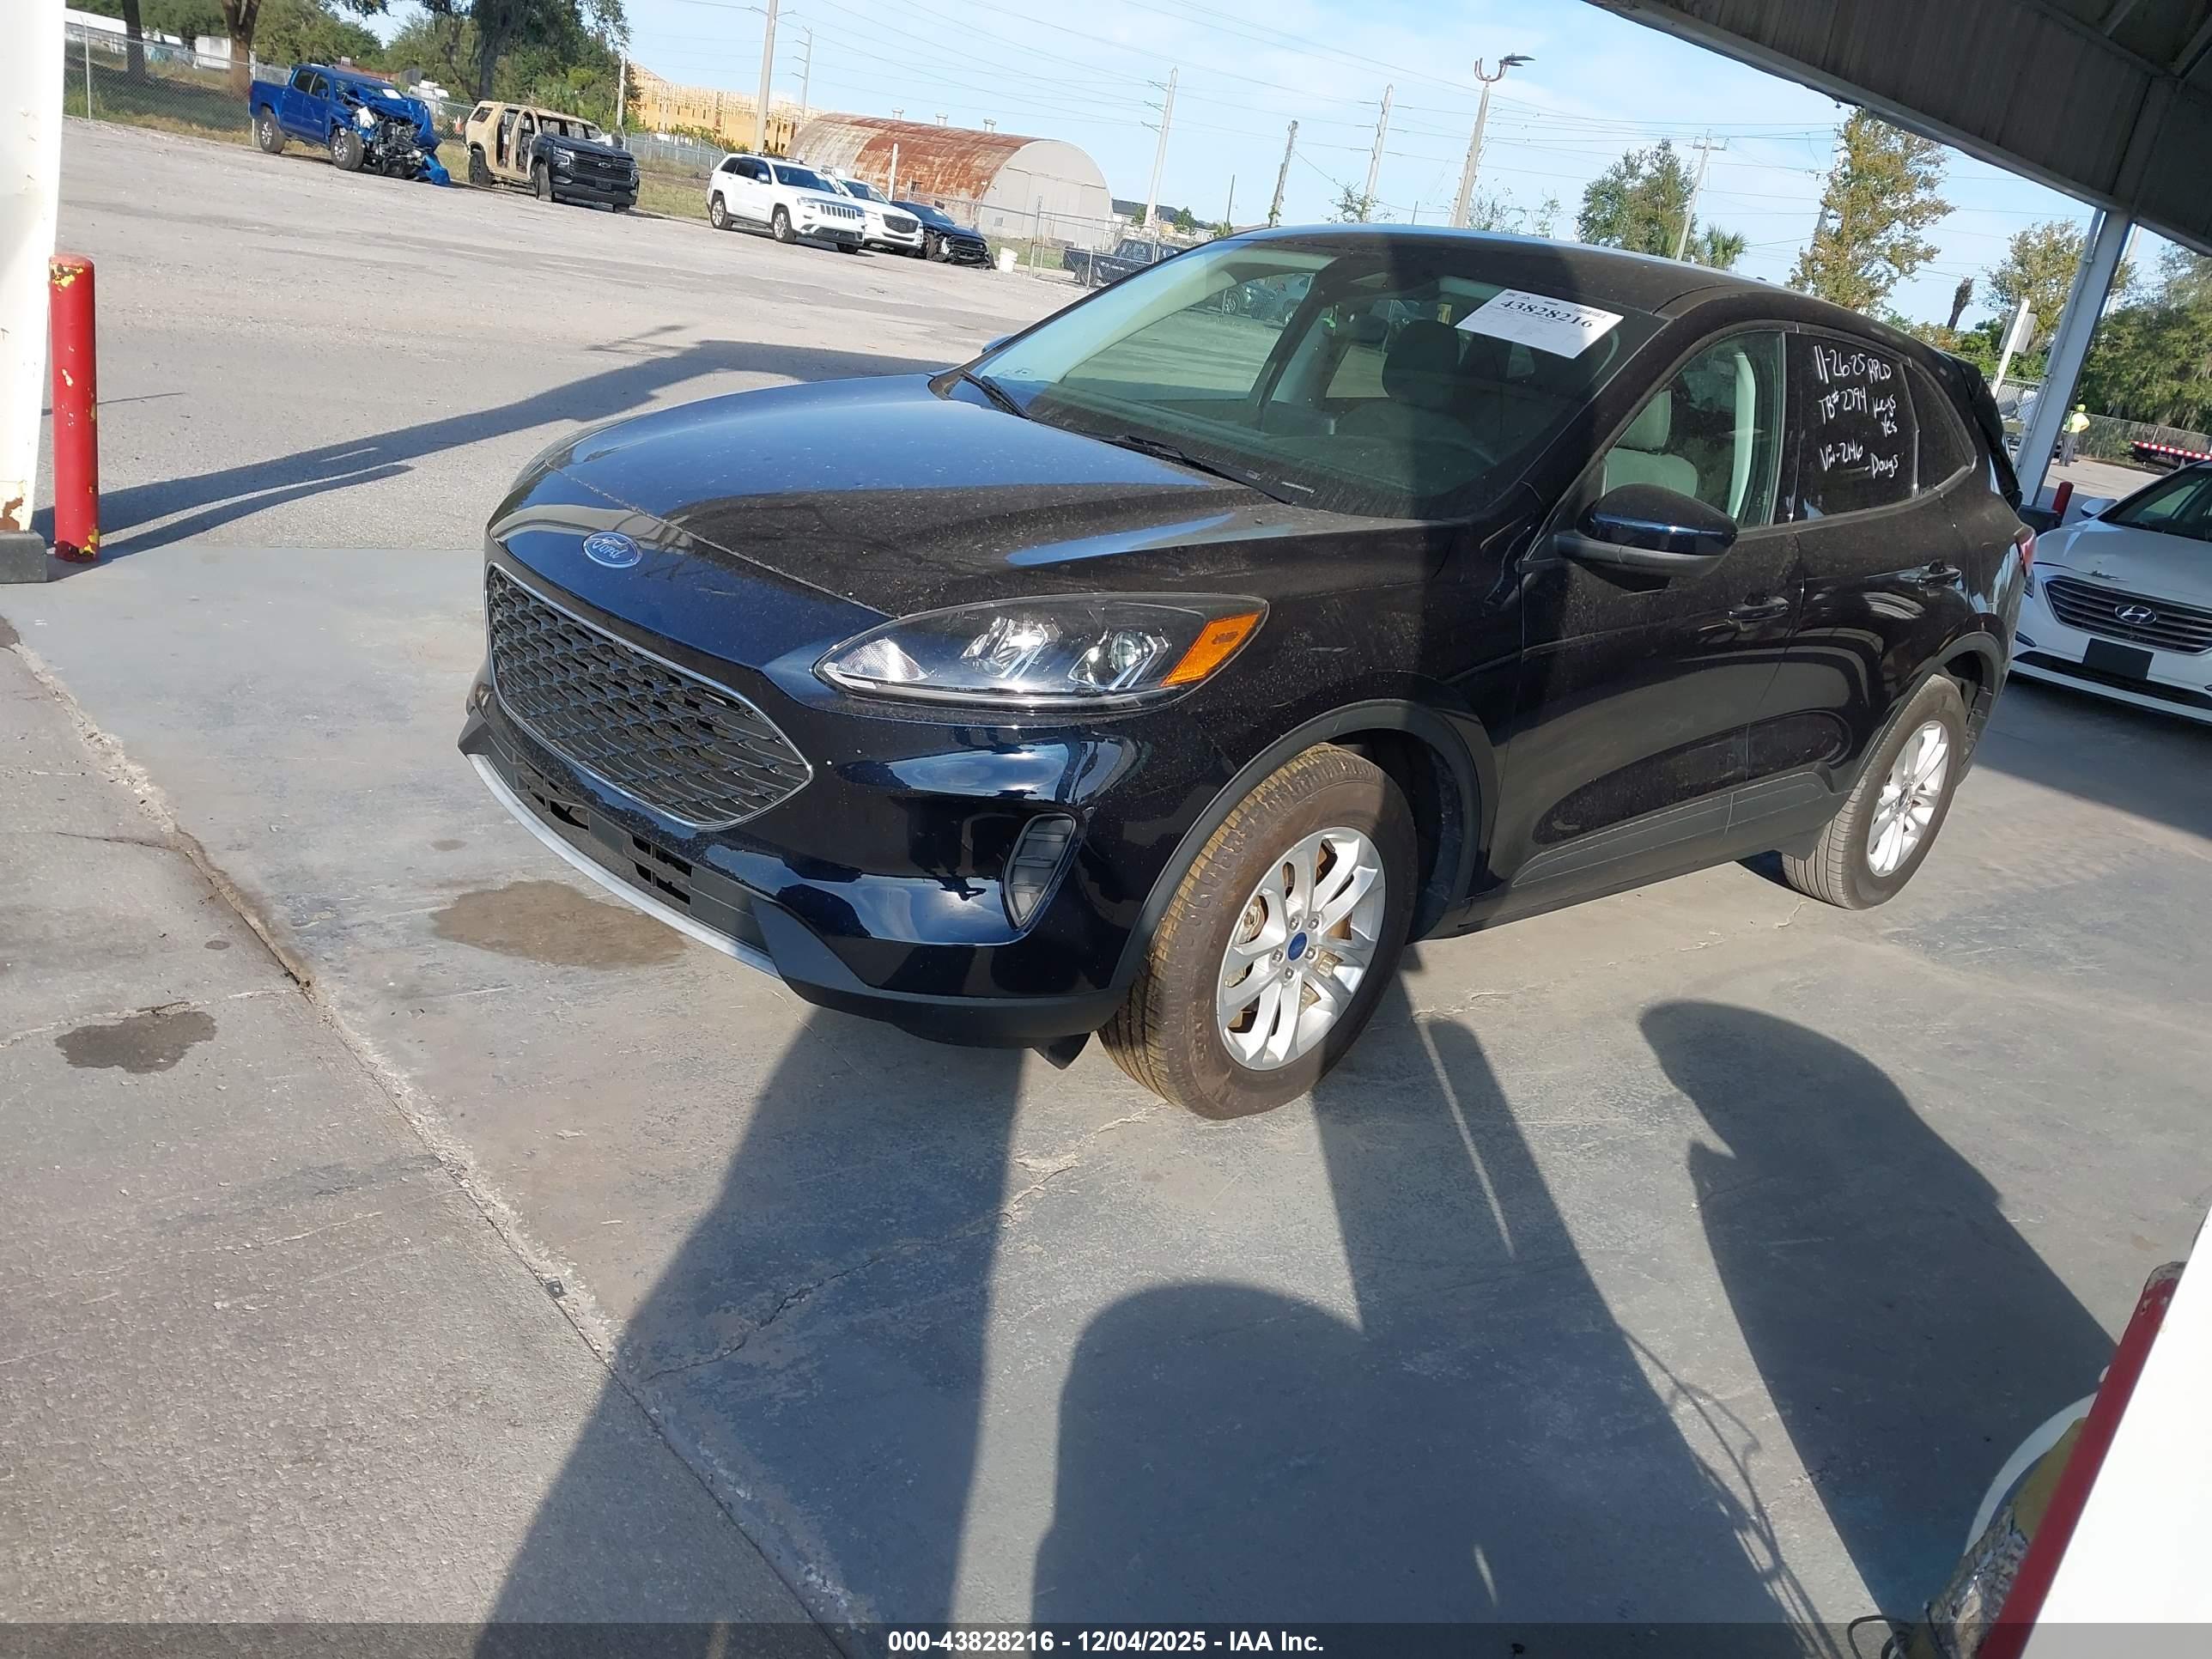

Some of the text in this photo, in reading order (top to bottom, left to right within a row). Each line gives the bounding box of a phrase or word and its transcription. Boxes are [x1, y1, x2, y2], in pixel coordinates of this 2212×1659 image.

[1500, 301, 1594, 328] 43828216
[1814, 344, 1866, 384] 11-26-25
[1881, 413, 1898, 438] Yes
[591, 536, 629, 559] Ford
